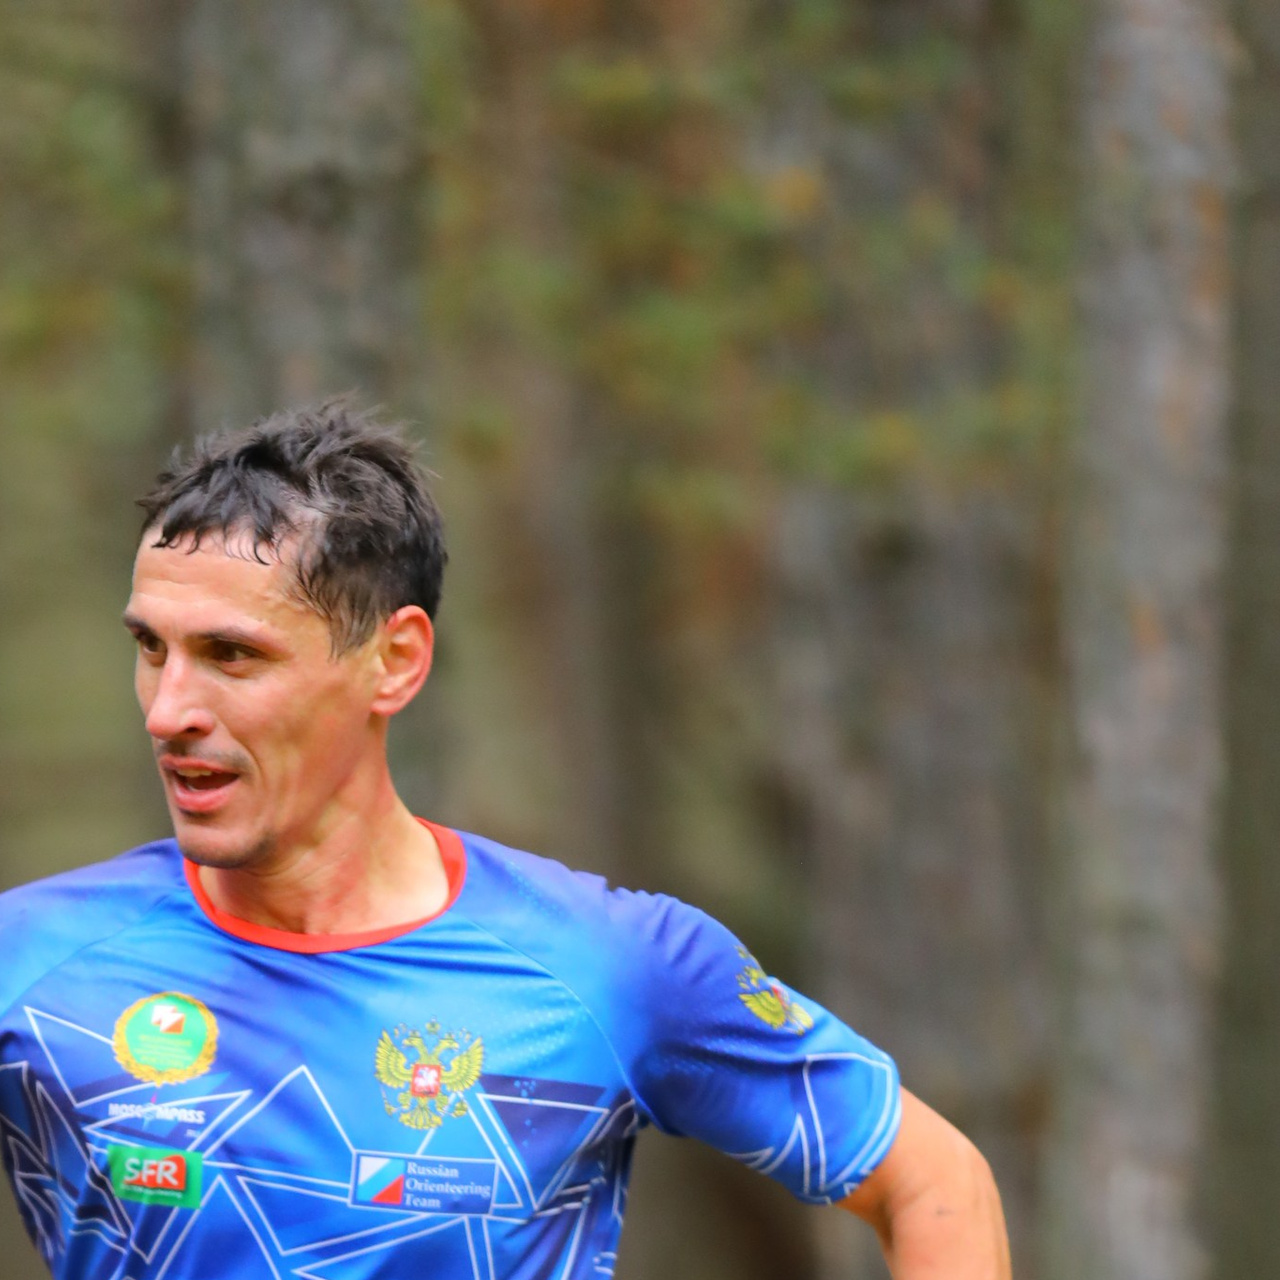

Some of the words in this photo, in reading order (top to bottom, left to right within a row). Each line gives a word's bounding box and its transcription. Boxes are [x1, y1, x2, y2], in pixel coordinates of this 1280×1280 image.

[124, 1156, 180, 1187] SFR
[407, 1161, 459, 1178] Russian
[405, 1178, 491, 1197] Orienteering
[404, 1193, 441, 1208] Team
